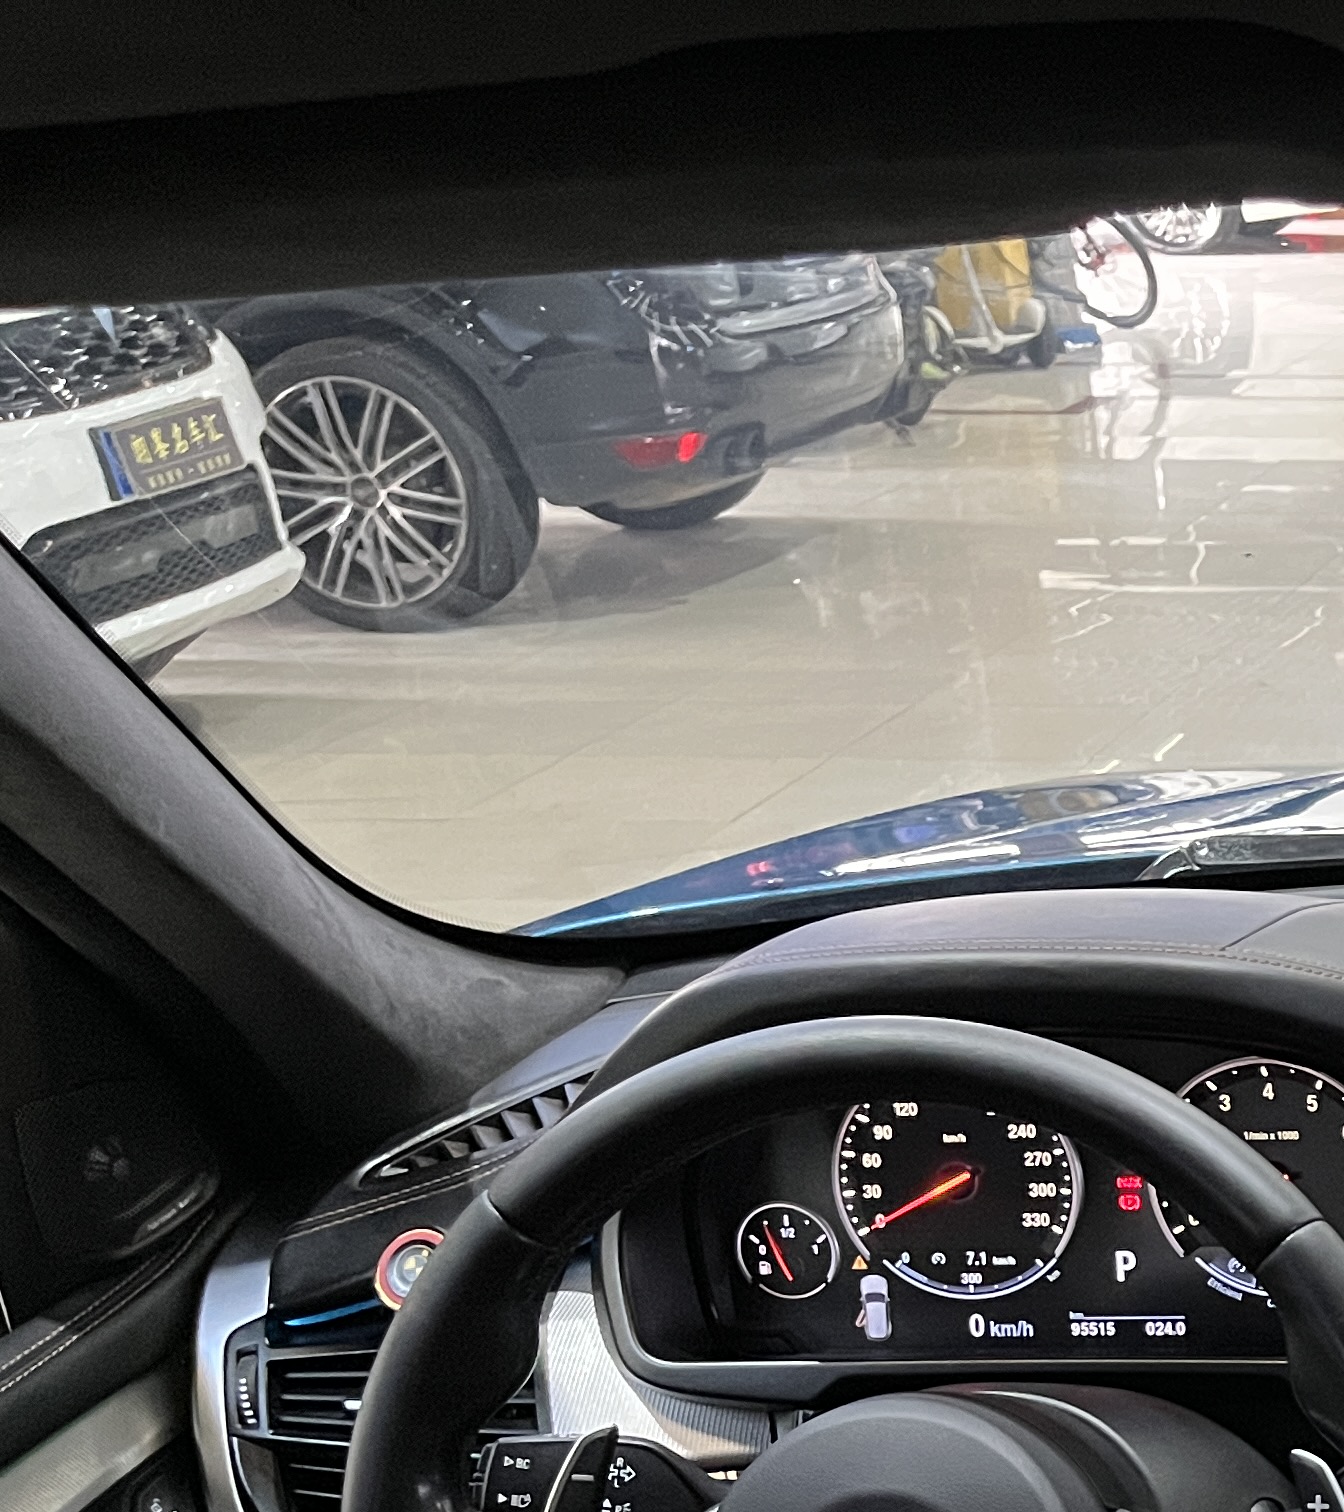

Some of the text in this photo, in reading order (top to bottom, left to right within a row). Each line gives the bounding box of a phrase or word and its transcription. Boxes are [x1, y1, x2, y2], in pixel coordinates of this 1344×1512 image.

[1262, 1082, 1275, 1101] 4
[893, 1102, 918, 1117] 120
[1218, 1094, 1232, 1112] 3
[1306, 1094, 1319, 1113] 5
[872, 1125, 893, 1140] 90
[1007, 1123, 1037, 1140] 240
[1277, 1130, 1299, 1142] 1000
[862, 1153, 882, 1169] 60
[1024, 1151, 1053, 1167] 270
[862, 1184, 882, 1199] 30
[1028, 1183, 1057, 1198] 300
[1022, 1213, 1051, 1228] 330
[779, 1227, 796, 1239] 1/2
[758, 1244, 767, 1256] 0
[811, 1243, 819, 1256] 1
[901, 1251, 911, 1264] 0
[965, 1251, 987, 1266] 7.1
[1114, 1249, 1138, 1282] P
[960, 1272, 983, 1285] 300
[969, 1313, 1035, 1339] 0 km/h
[1070, 1321, 1186, 1337] 95515 024.0
